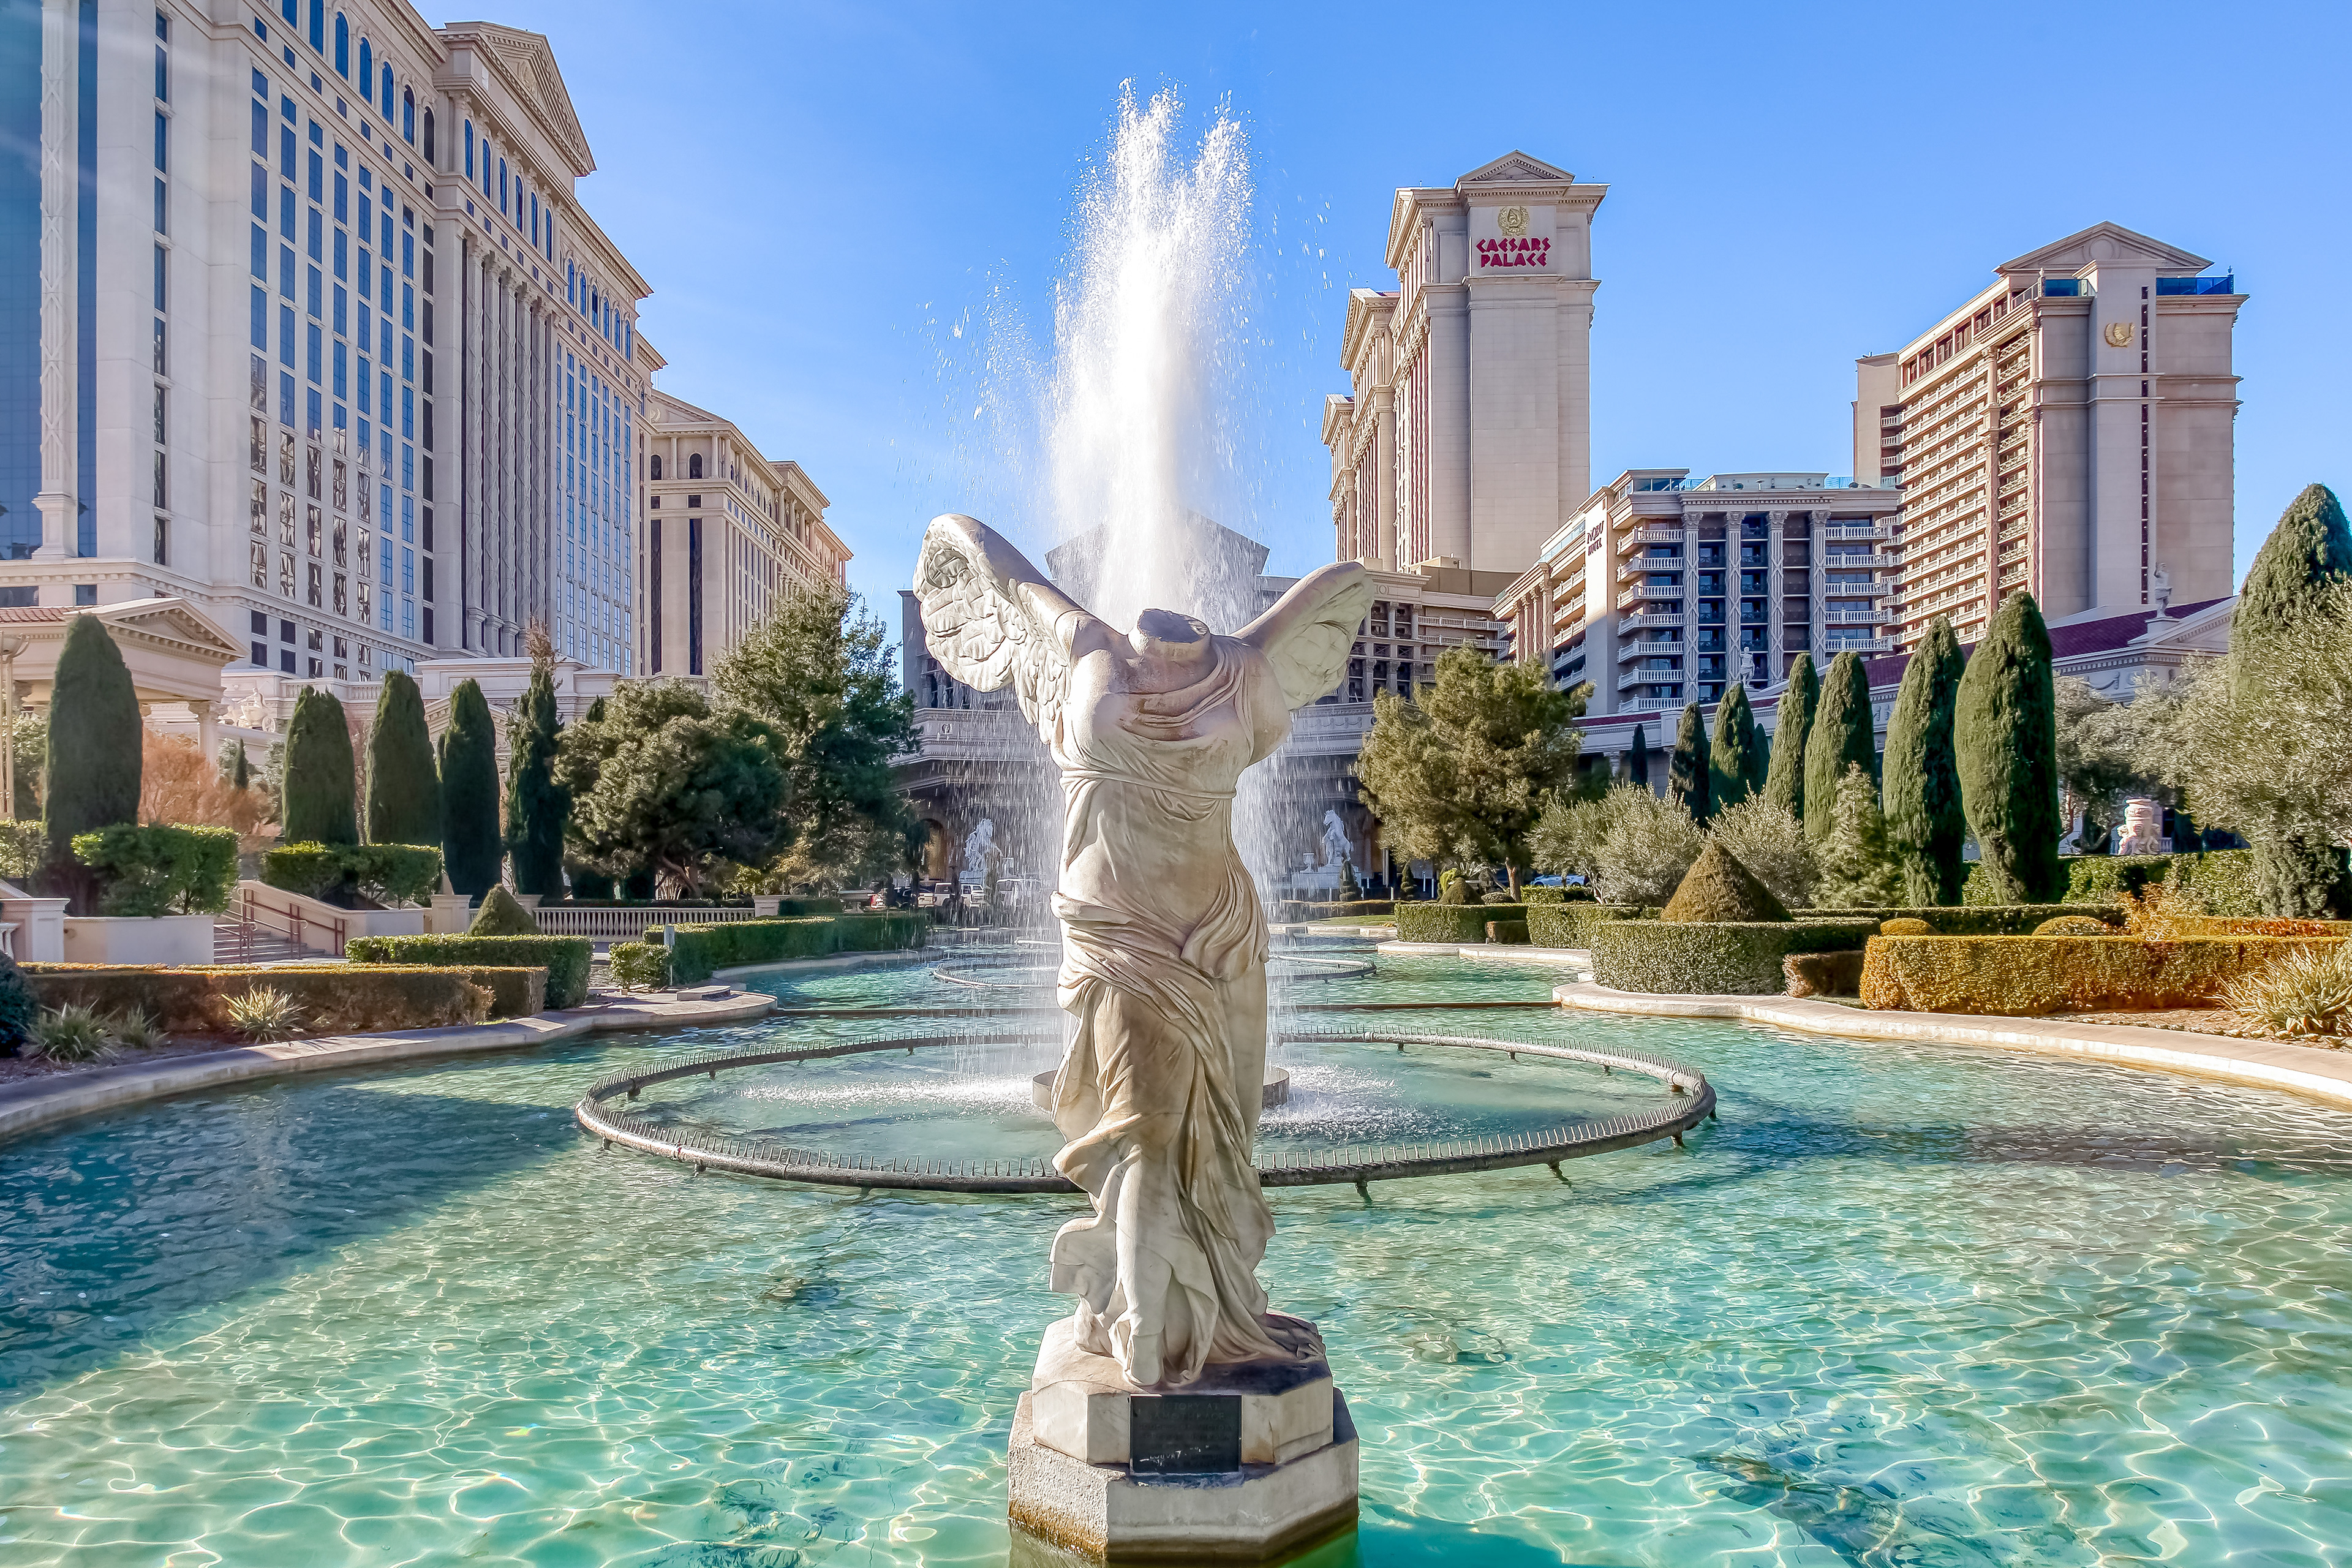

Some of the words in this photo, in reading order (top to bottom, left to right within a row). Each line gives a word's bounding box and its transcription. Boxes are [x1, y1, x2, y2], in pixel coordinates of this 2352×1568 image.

[1476, 237, 1551, 254] CAESARS
[1481, 252, 1547, 268] PALACE
[1587, 521, 1604, 544] NOBU
[1588, 538, 1602, 556] HOTEL
[1207, 1402, 1219, 1411] AT
